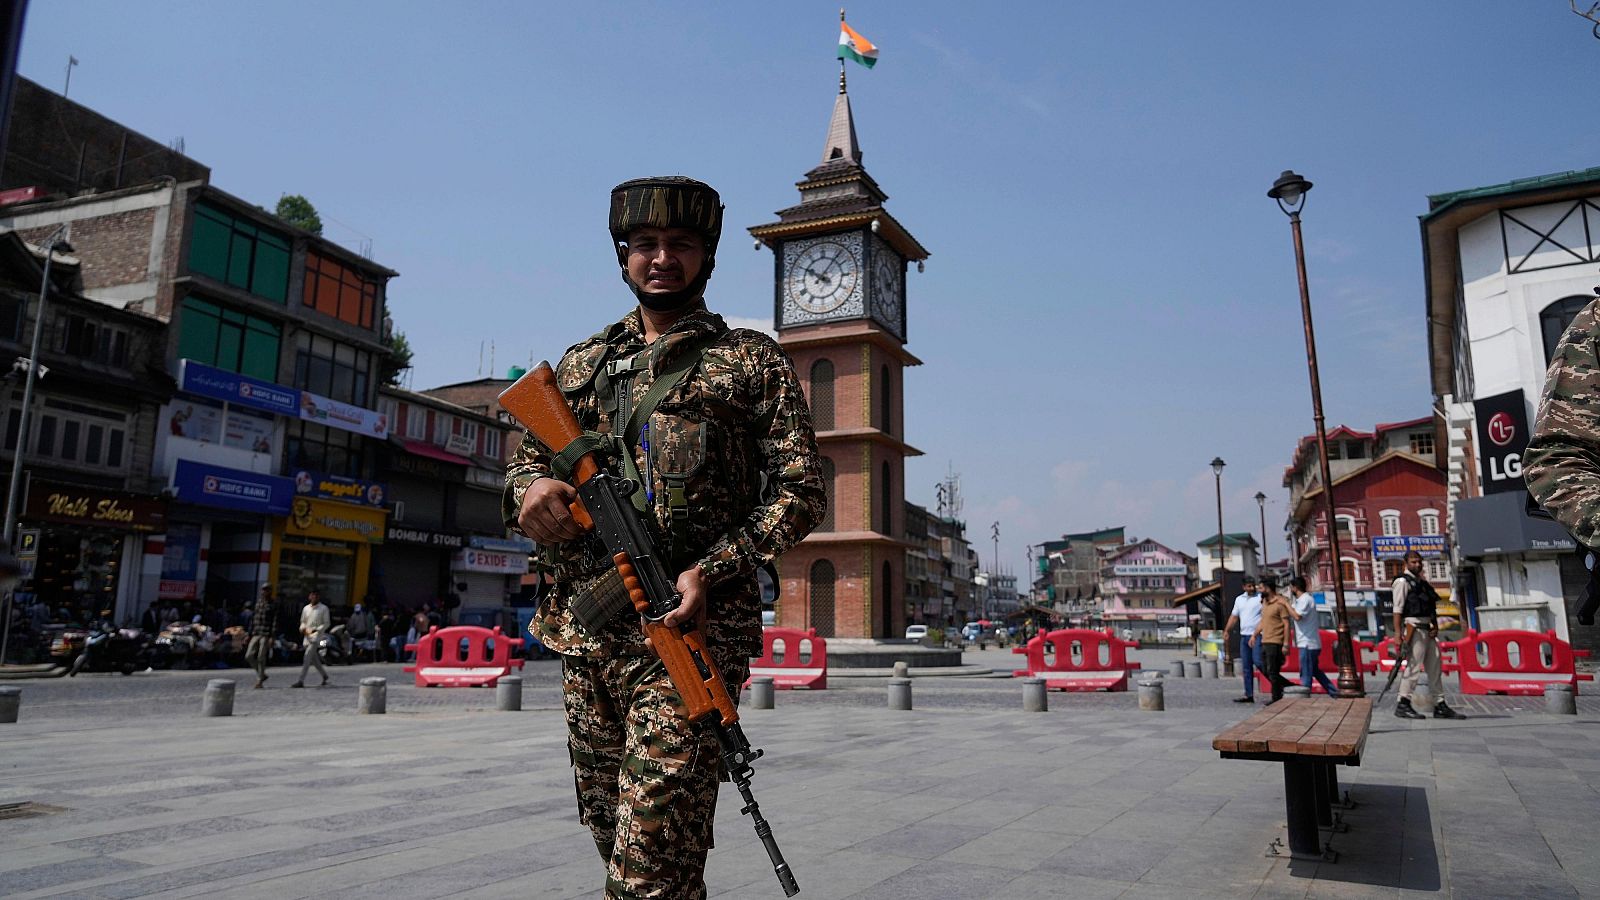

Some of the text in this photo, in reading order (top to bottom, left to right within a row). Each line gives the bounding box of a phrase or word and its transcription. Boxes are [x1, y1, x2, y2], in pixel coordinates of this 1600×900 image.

[271, 393, 291, 405] BANK
[1489, 453, 1522, 481] LG
[219, 482, 267, 498] HDFC BANK
[48, 493, 135, 522] Walk Shoes
[25, 535, 33, 547] P
[388, 528, 429, 542] BOMBAY
[433, 533, 463, 547] STORE
[477, 552, 507, 567] EXIDE
